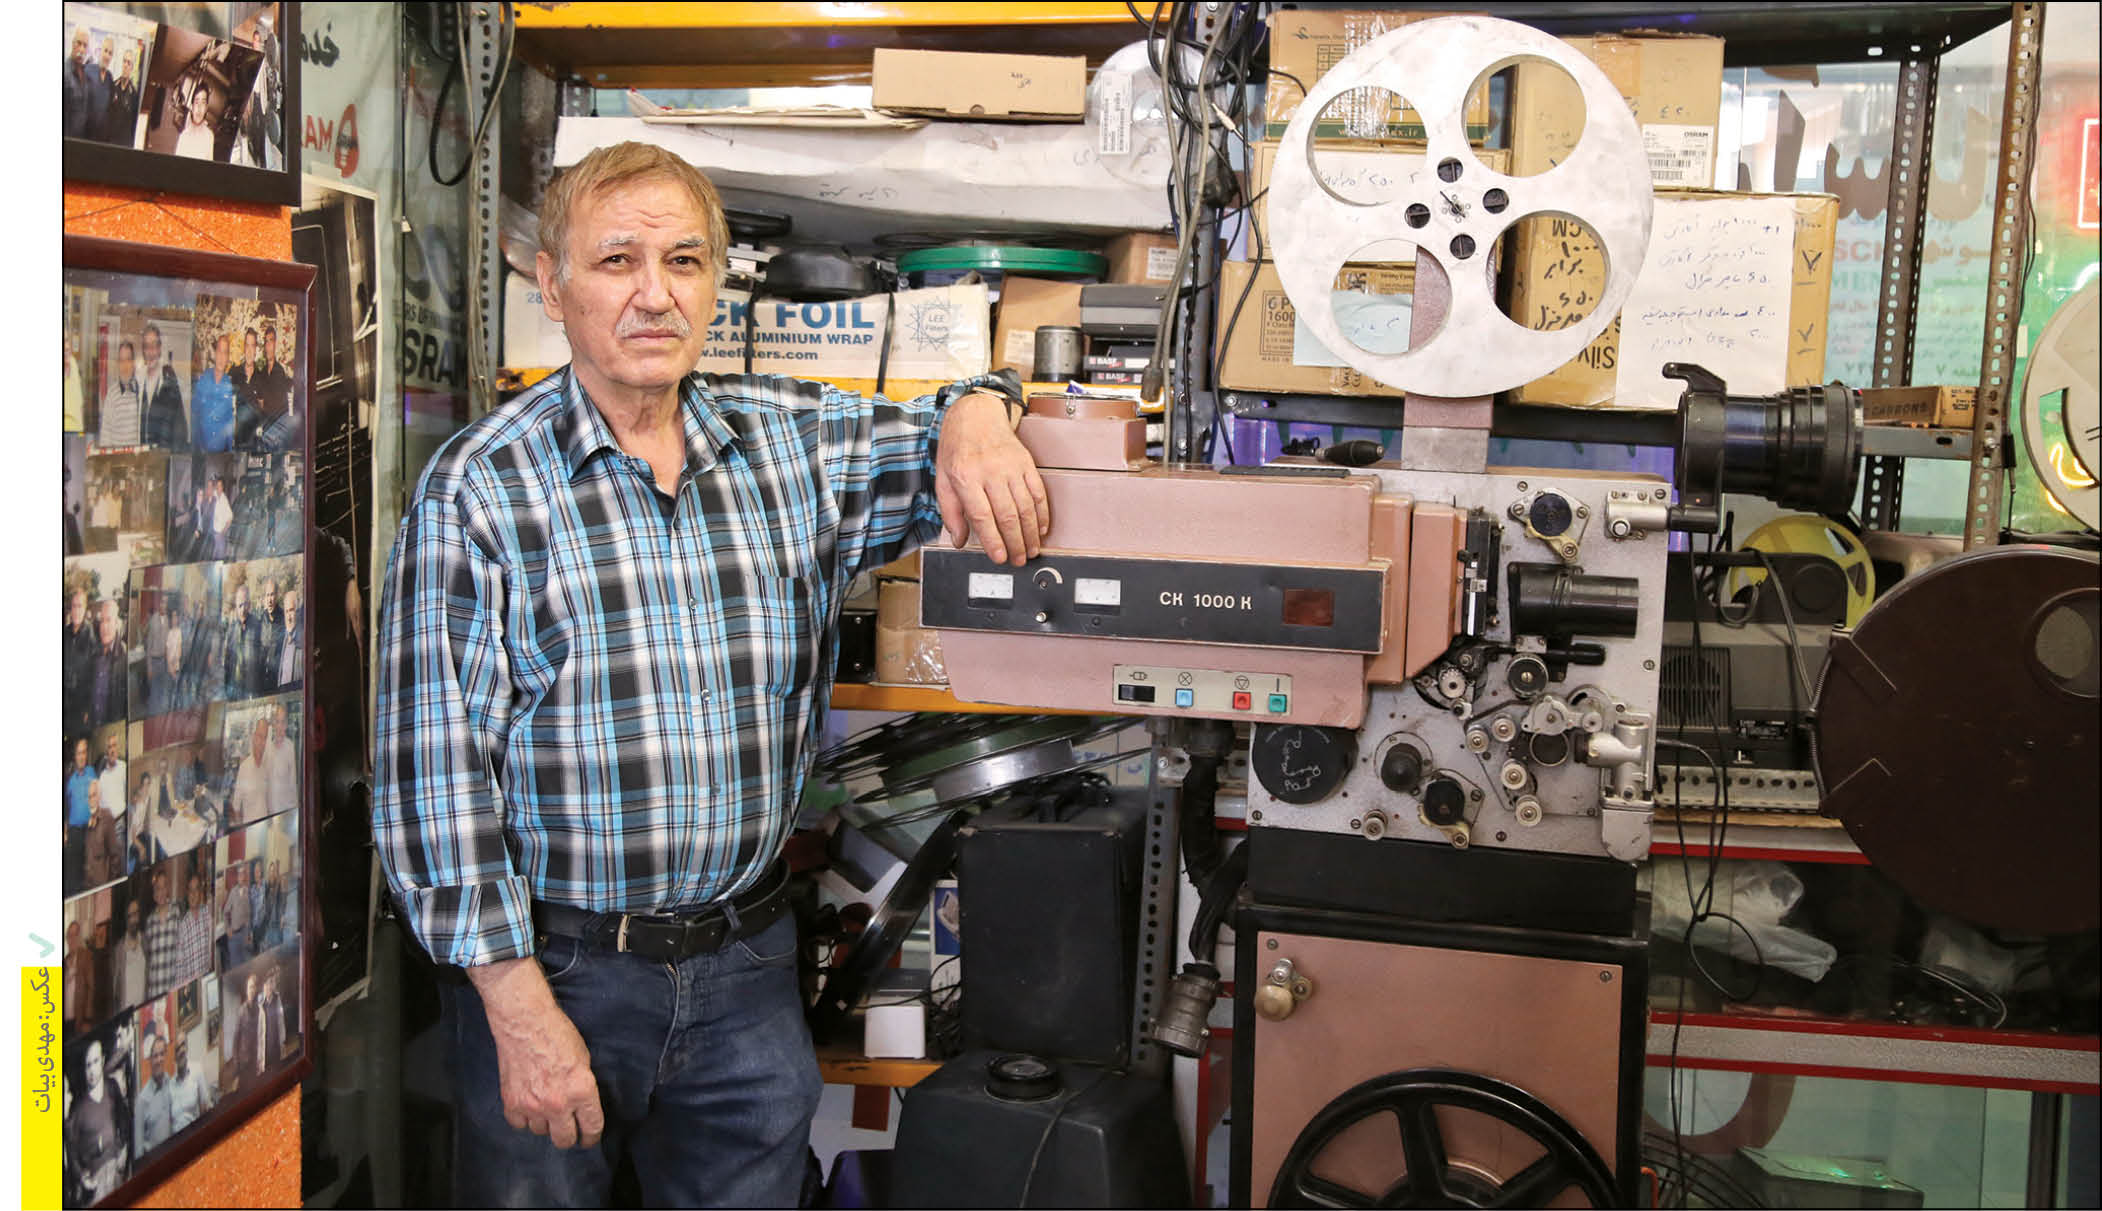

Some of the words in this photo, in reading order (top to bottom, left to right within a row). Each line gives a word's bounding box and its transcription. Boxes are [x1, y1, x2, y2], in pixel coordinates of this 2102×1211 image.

[301, 114, 334, 152] AM
[776, 301, 875, 329] FOIL
[729, 331, 822, 345] ALUMINIUM
[827, 333, 874, 346] WRAP
[1193, 594, 1235, 609] 1000
